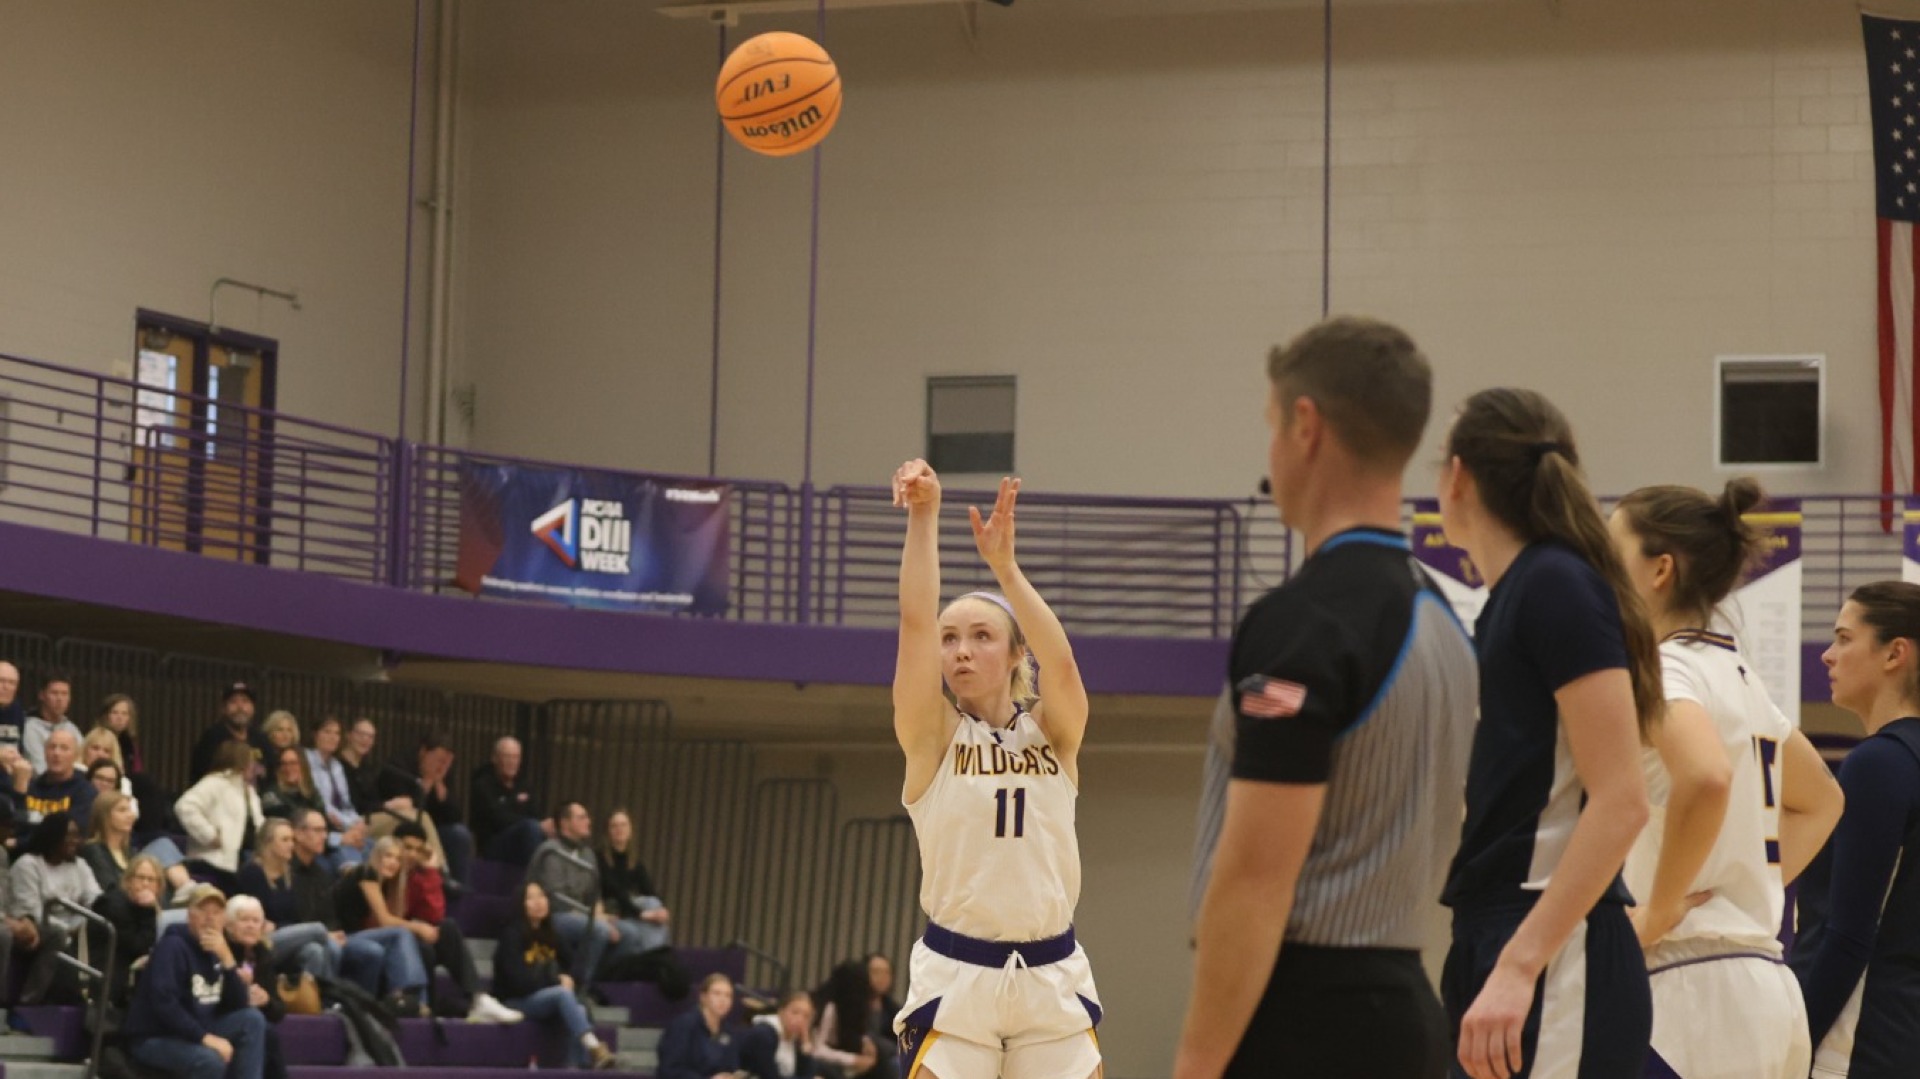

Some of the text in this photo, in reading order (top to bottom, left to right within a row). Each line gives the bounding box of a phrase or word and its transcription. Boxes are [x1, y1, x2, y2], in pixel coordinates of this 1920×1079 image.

[741, 104, 823, 138] Wilson
[580, 516, 631, 552] DIII
[580, 550, 630, 574] WEEK
[994, 787, 1026, 839] 11
